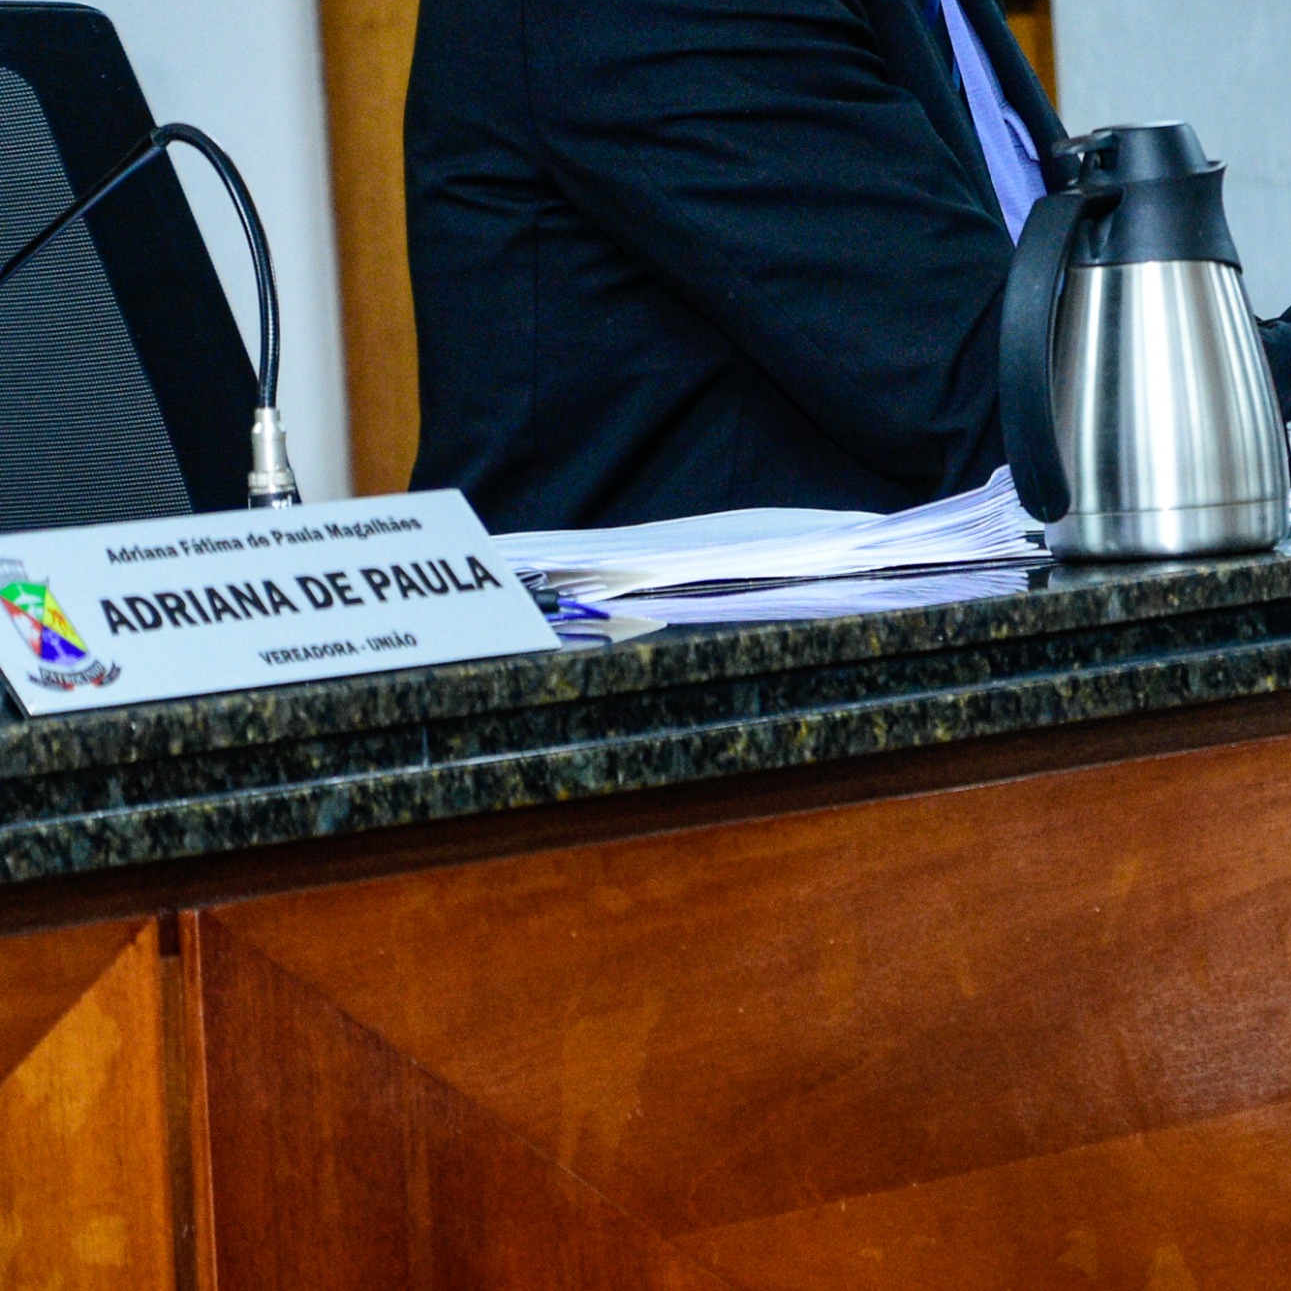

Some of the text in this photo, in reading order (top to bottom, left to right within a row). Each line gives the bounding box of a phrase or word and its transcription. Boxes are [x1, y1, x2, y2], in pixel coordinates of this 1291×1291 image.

[106, 516, 422, 564] Adriana Fátima de Paula Magalhães
[101, 556, 502, 634] ADRIANA DE PAULA
[258, 641, 357, 665] VEREADORA
[367, 632, 418, 651] UNIÃO
